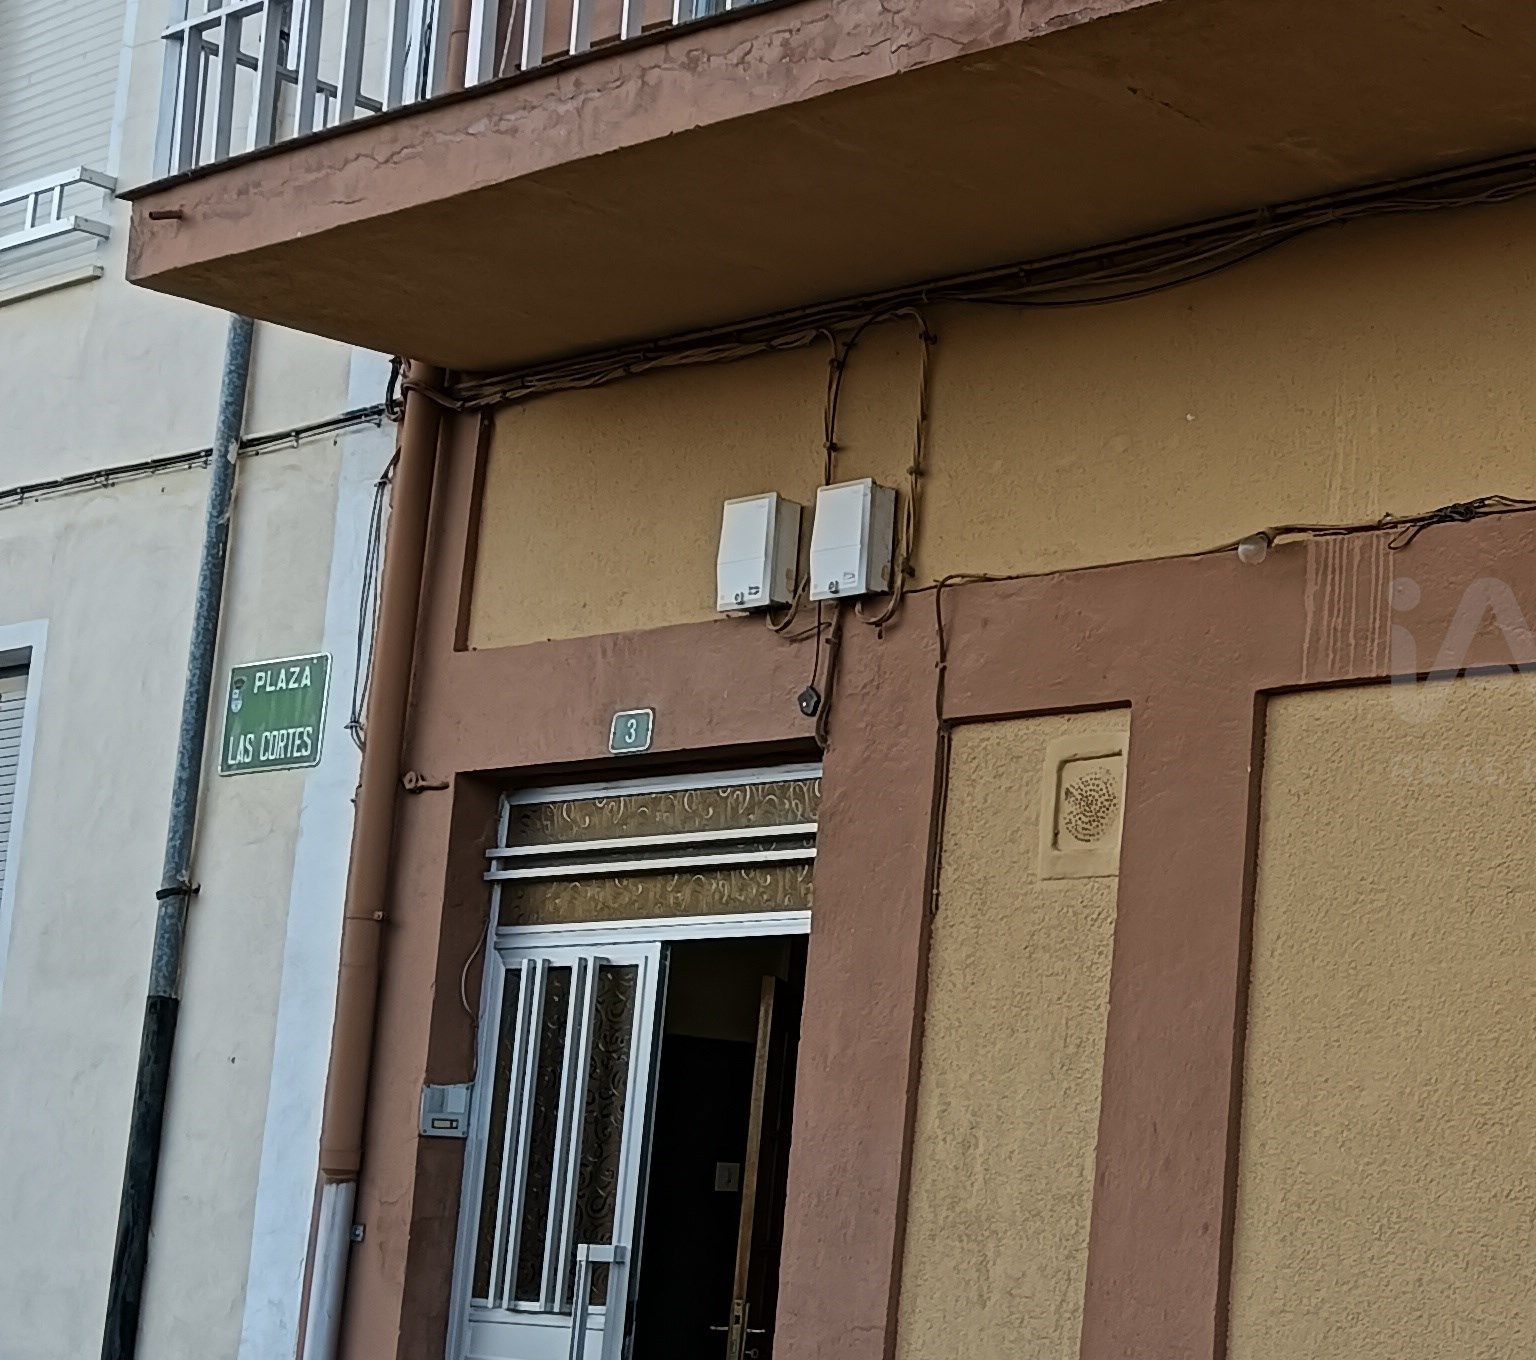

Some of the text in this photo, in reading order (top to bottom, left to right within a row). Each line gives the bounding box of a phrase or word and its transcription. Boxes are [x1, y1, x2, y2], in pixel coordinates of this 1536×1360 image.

[253, 665, 311, 694] PLAZA
[625, 718, 637, 743] 3
[227, 726, 313, 765] LAS CORTES
